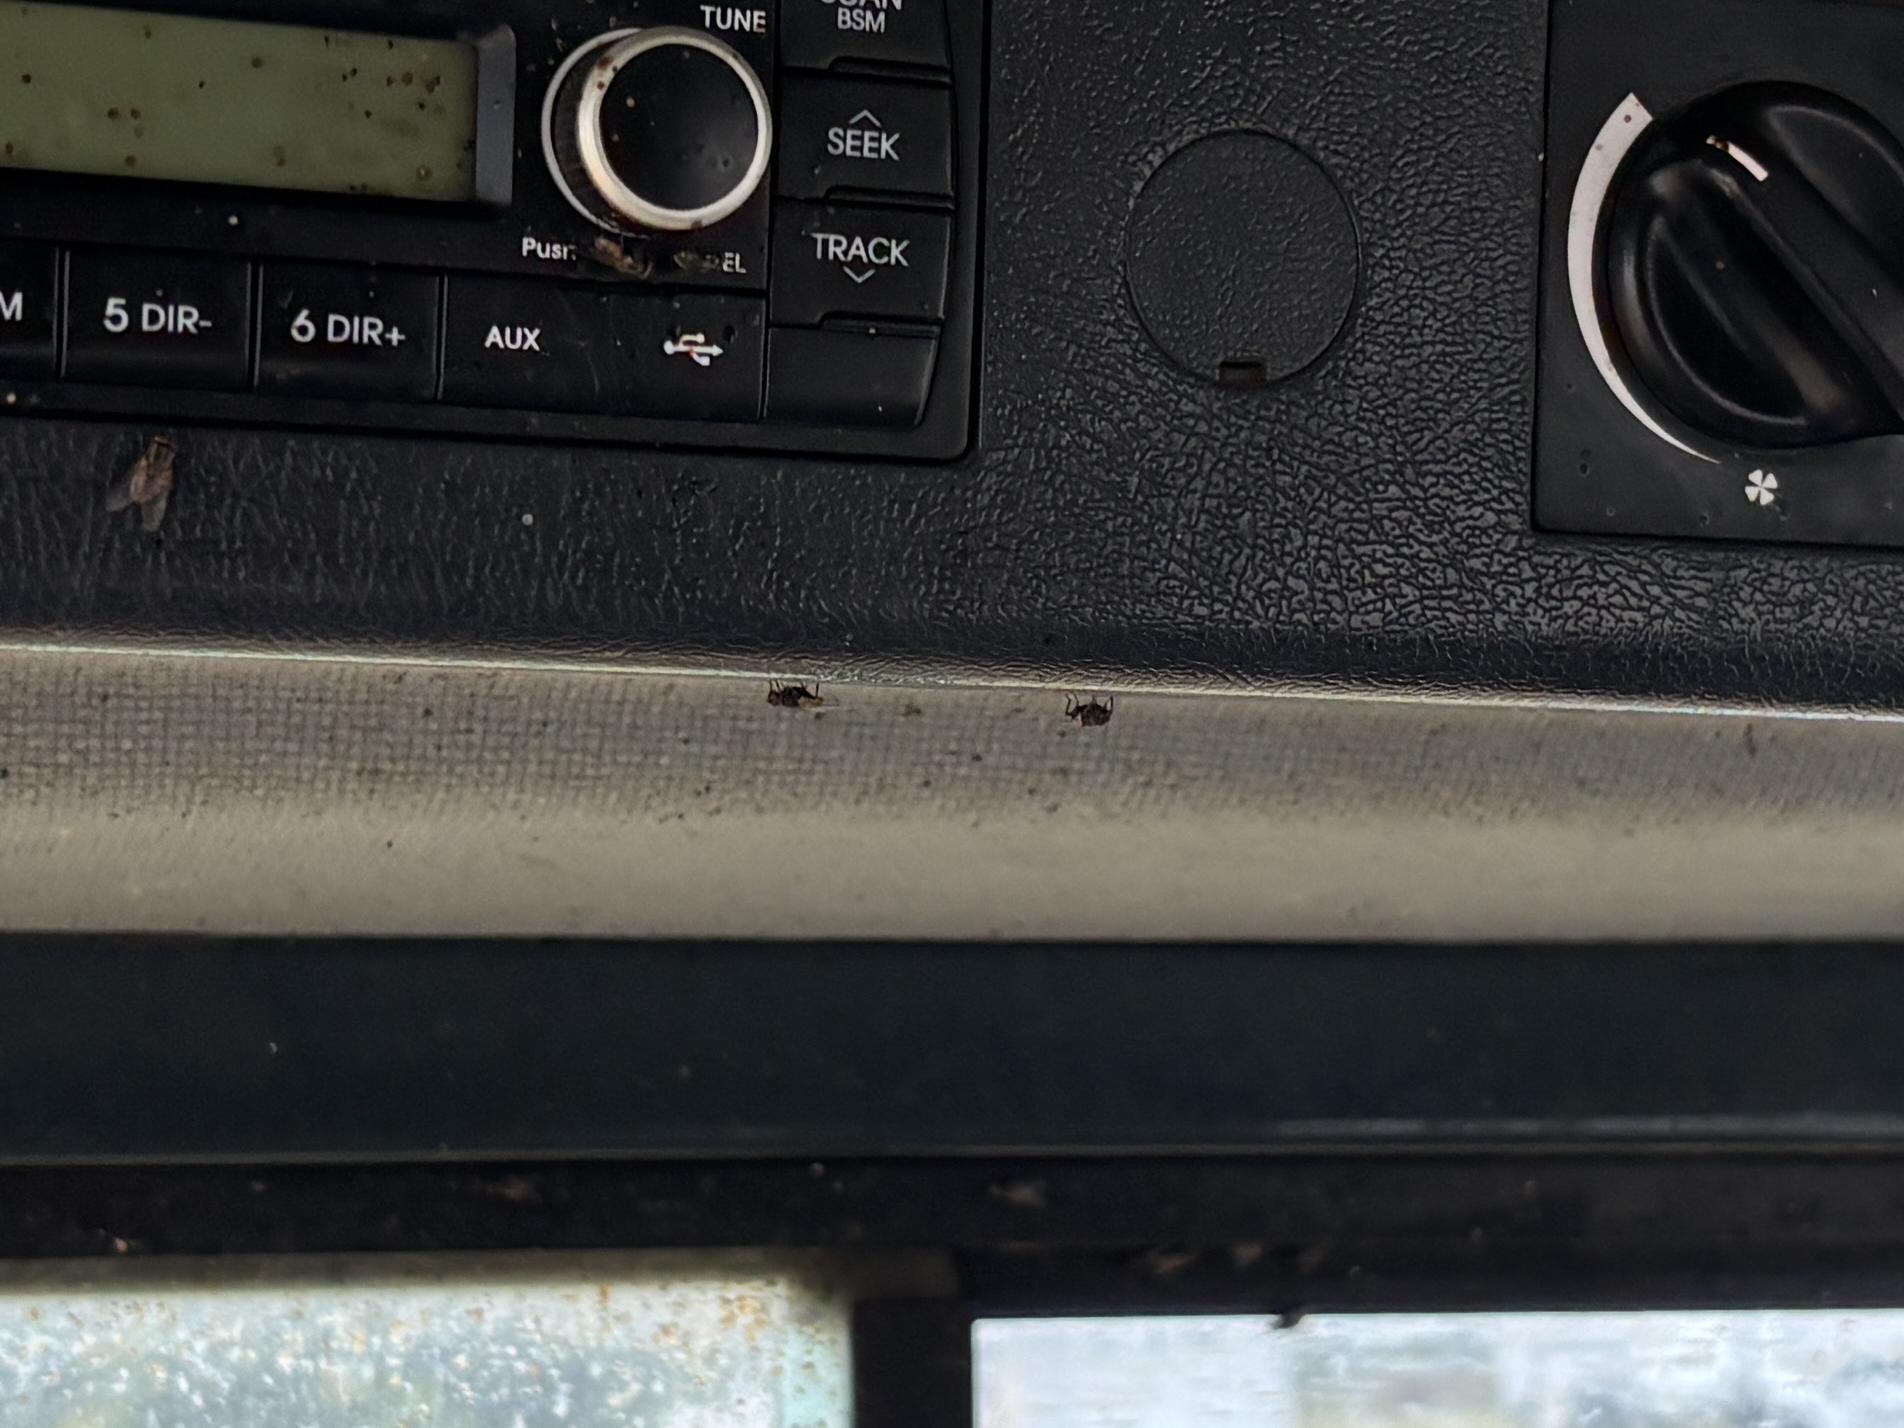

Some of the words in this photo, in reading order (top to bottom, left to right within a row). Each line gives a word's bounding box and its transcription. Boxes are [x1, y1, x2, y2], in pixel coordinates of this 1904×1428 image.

[699, 3, 767, 34] TUNE
[835, 7, 888, 35] BSM
[826, 126, 901, 162] SEEK
[810, 232, 910, 268] TRACK
[102, 296, 130, 334] 5
[140, 301, 213, 335] DIR-
[289, 307, 317, 344] 6
[326, 312, 407, 348] DIR+
[483, 324, 542, 352] AUX
